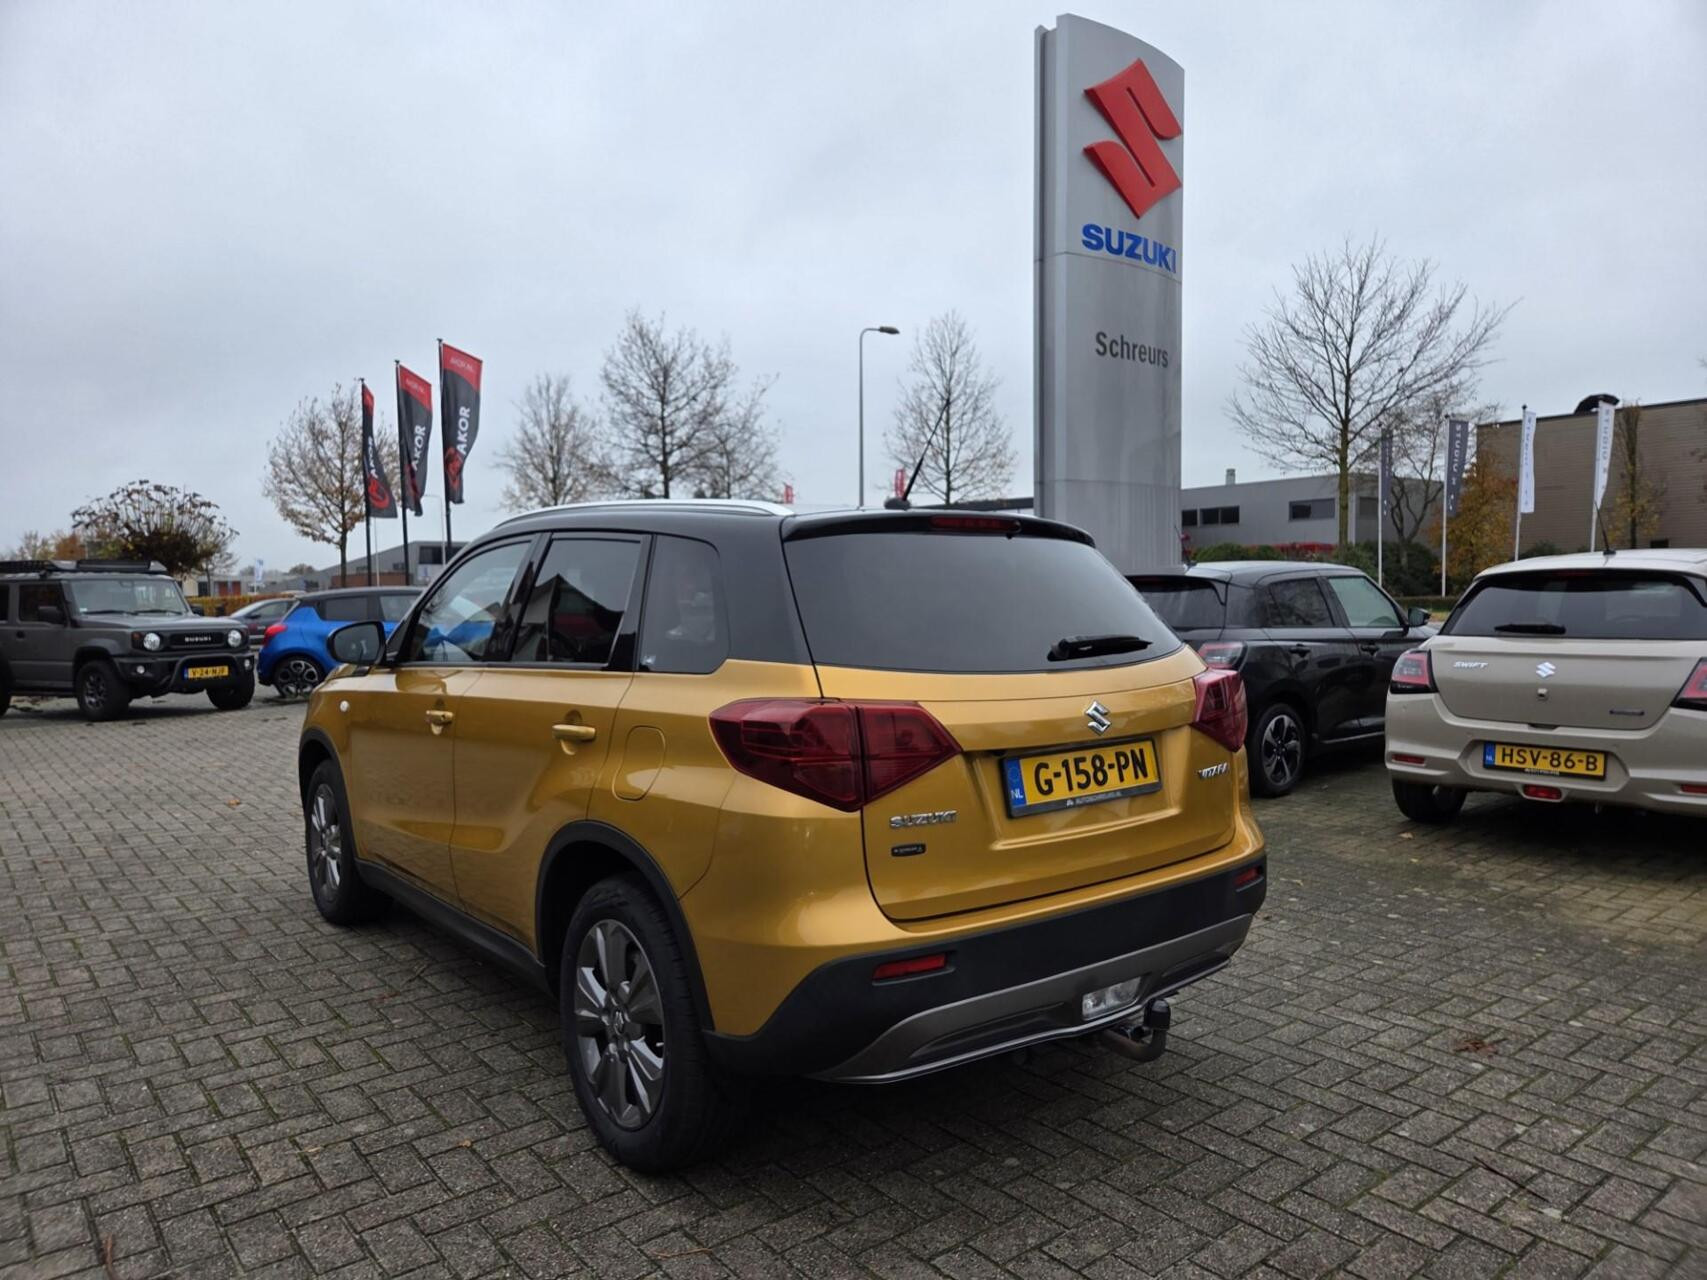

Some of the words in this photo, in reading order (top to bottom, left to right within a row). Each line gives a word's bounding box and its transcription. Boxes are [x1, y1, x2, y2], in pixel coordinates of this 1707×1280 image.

[1082, 223, 1177, 274] SUZUKI
[1095, 331, 1169, 369] Schreurs
[413, 425, 426, 471] AKOR
[456, 406, 471, 455] AKOR
[1453, 660, 1489, 669] SWIFT
[1034, 748, 1148, 796] G-158-PN
[1501, 747, 1598, 772] HSV-86-B
[1010, 789, 1024, 799] NL
[890, 810, 957, 829] SUZUKI
